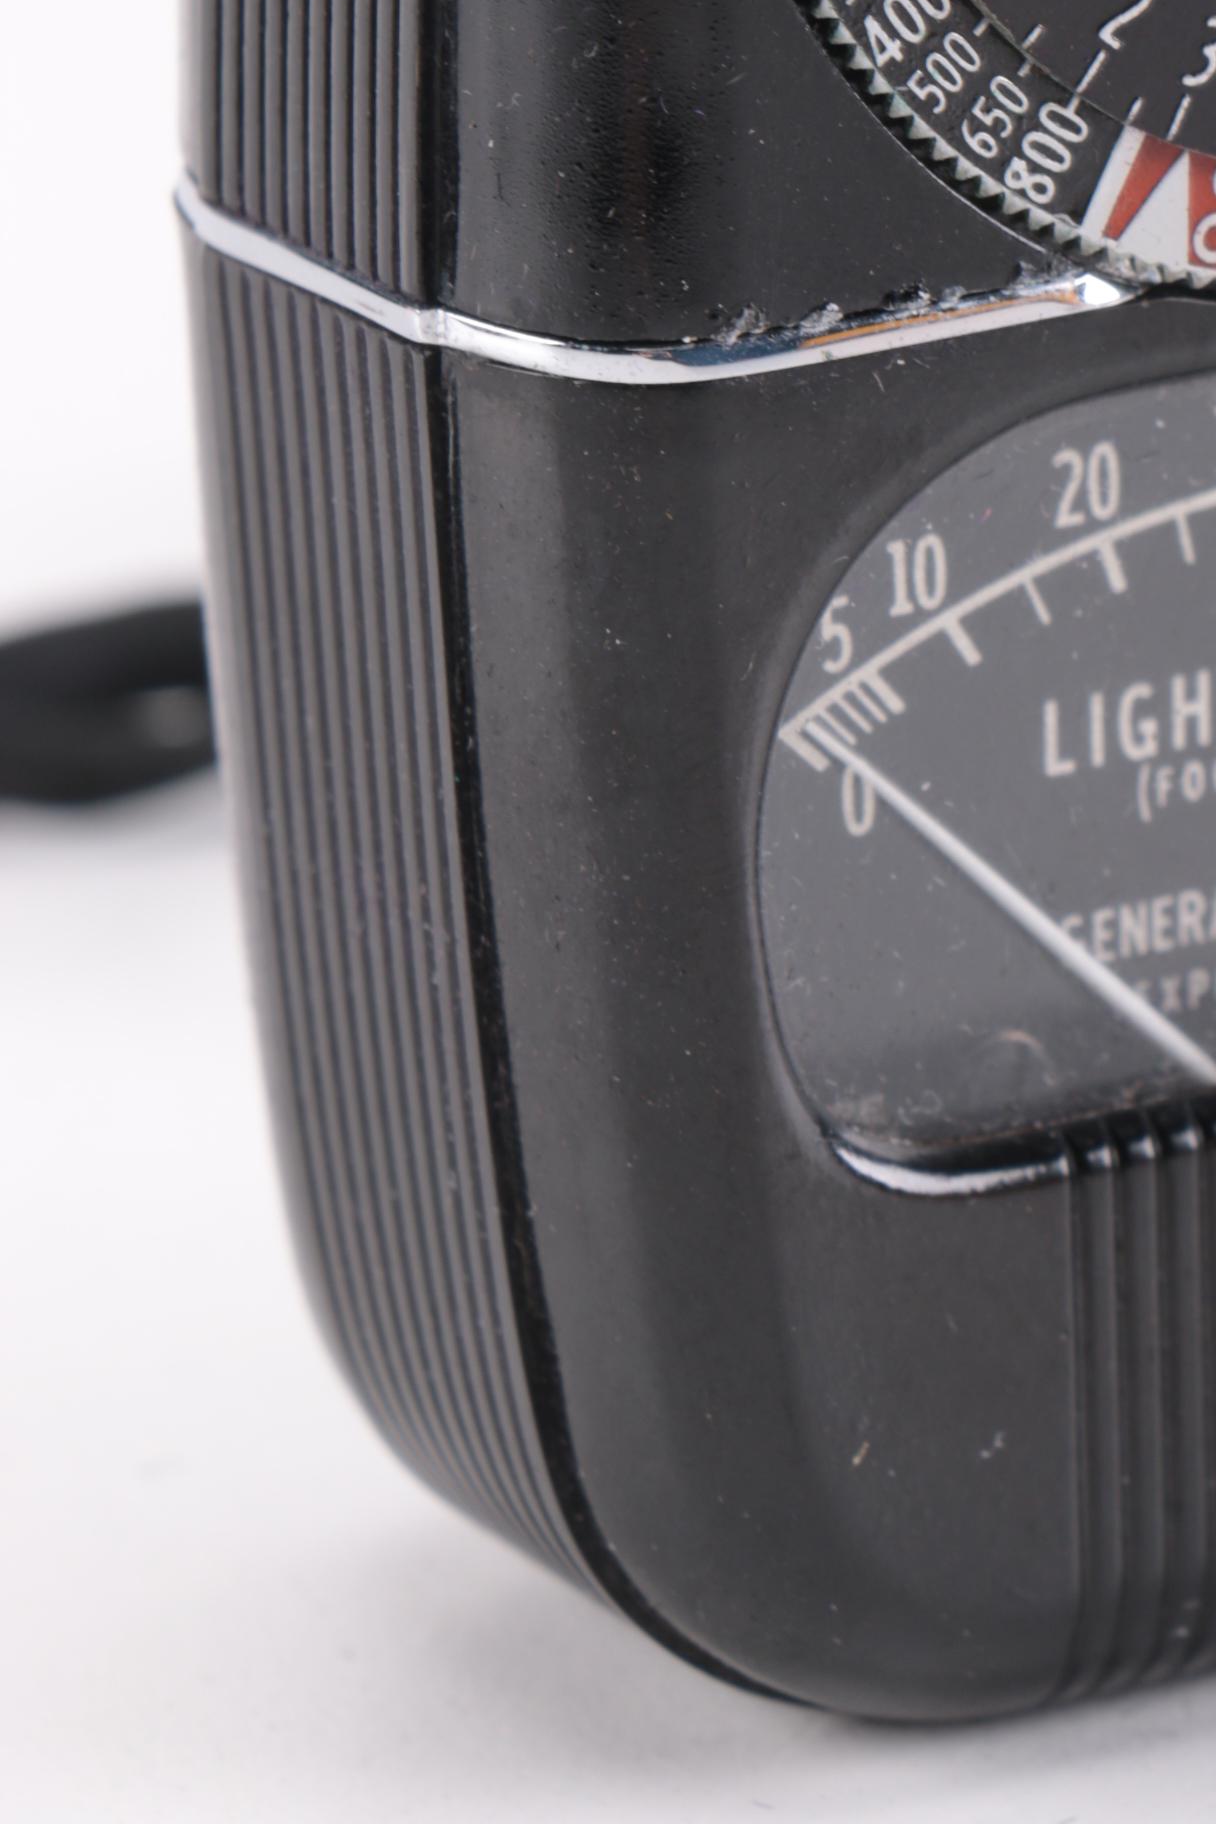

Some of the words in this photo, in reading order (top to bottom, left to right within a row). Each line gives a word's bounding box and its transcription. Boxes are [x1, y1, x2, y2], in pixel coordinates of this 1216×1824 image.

[907, 32, 982, 114] 500
[961, 76, 1030, 159] 650
[1004, 102, 1089, 205] 800
[1051, 441, 1121, 530] 20
[887, 533, 947, 617] 10
[820, 594, 853, 674] 5
